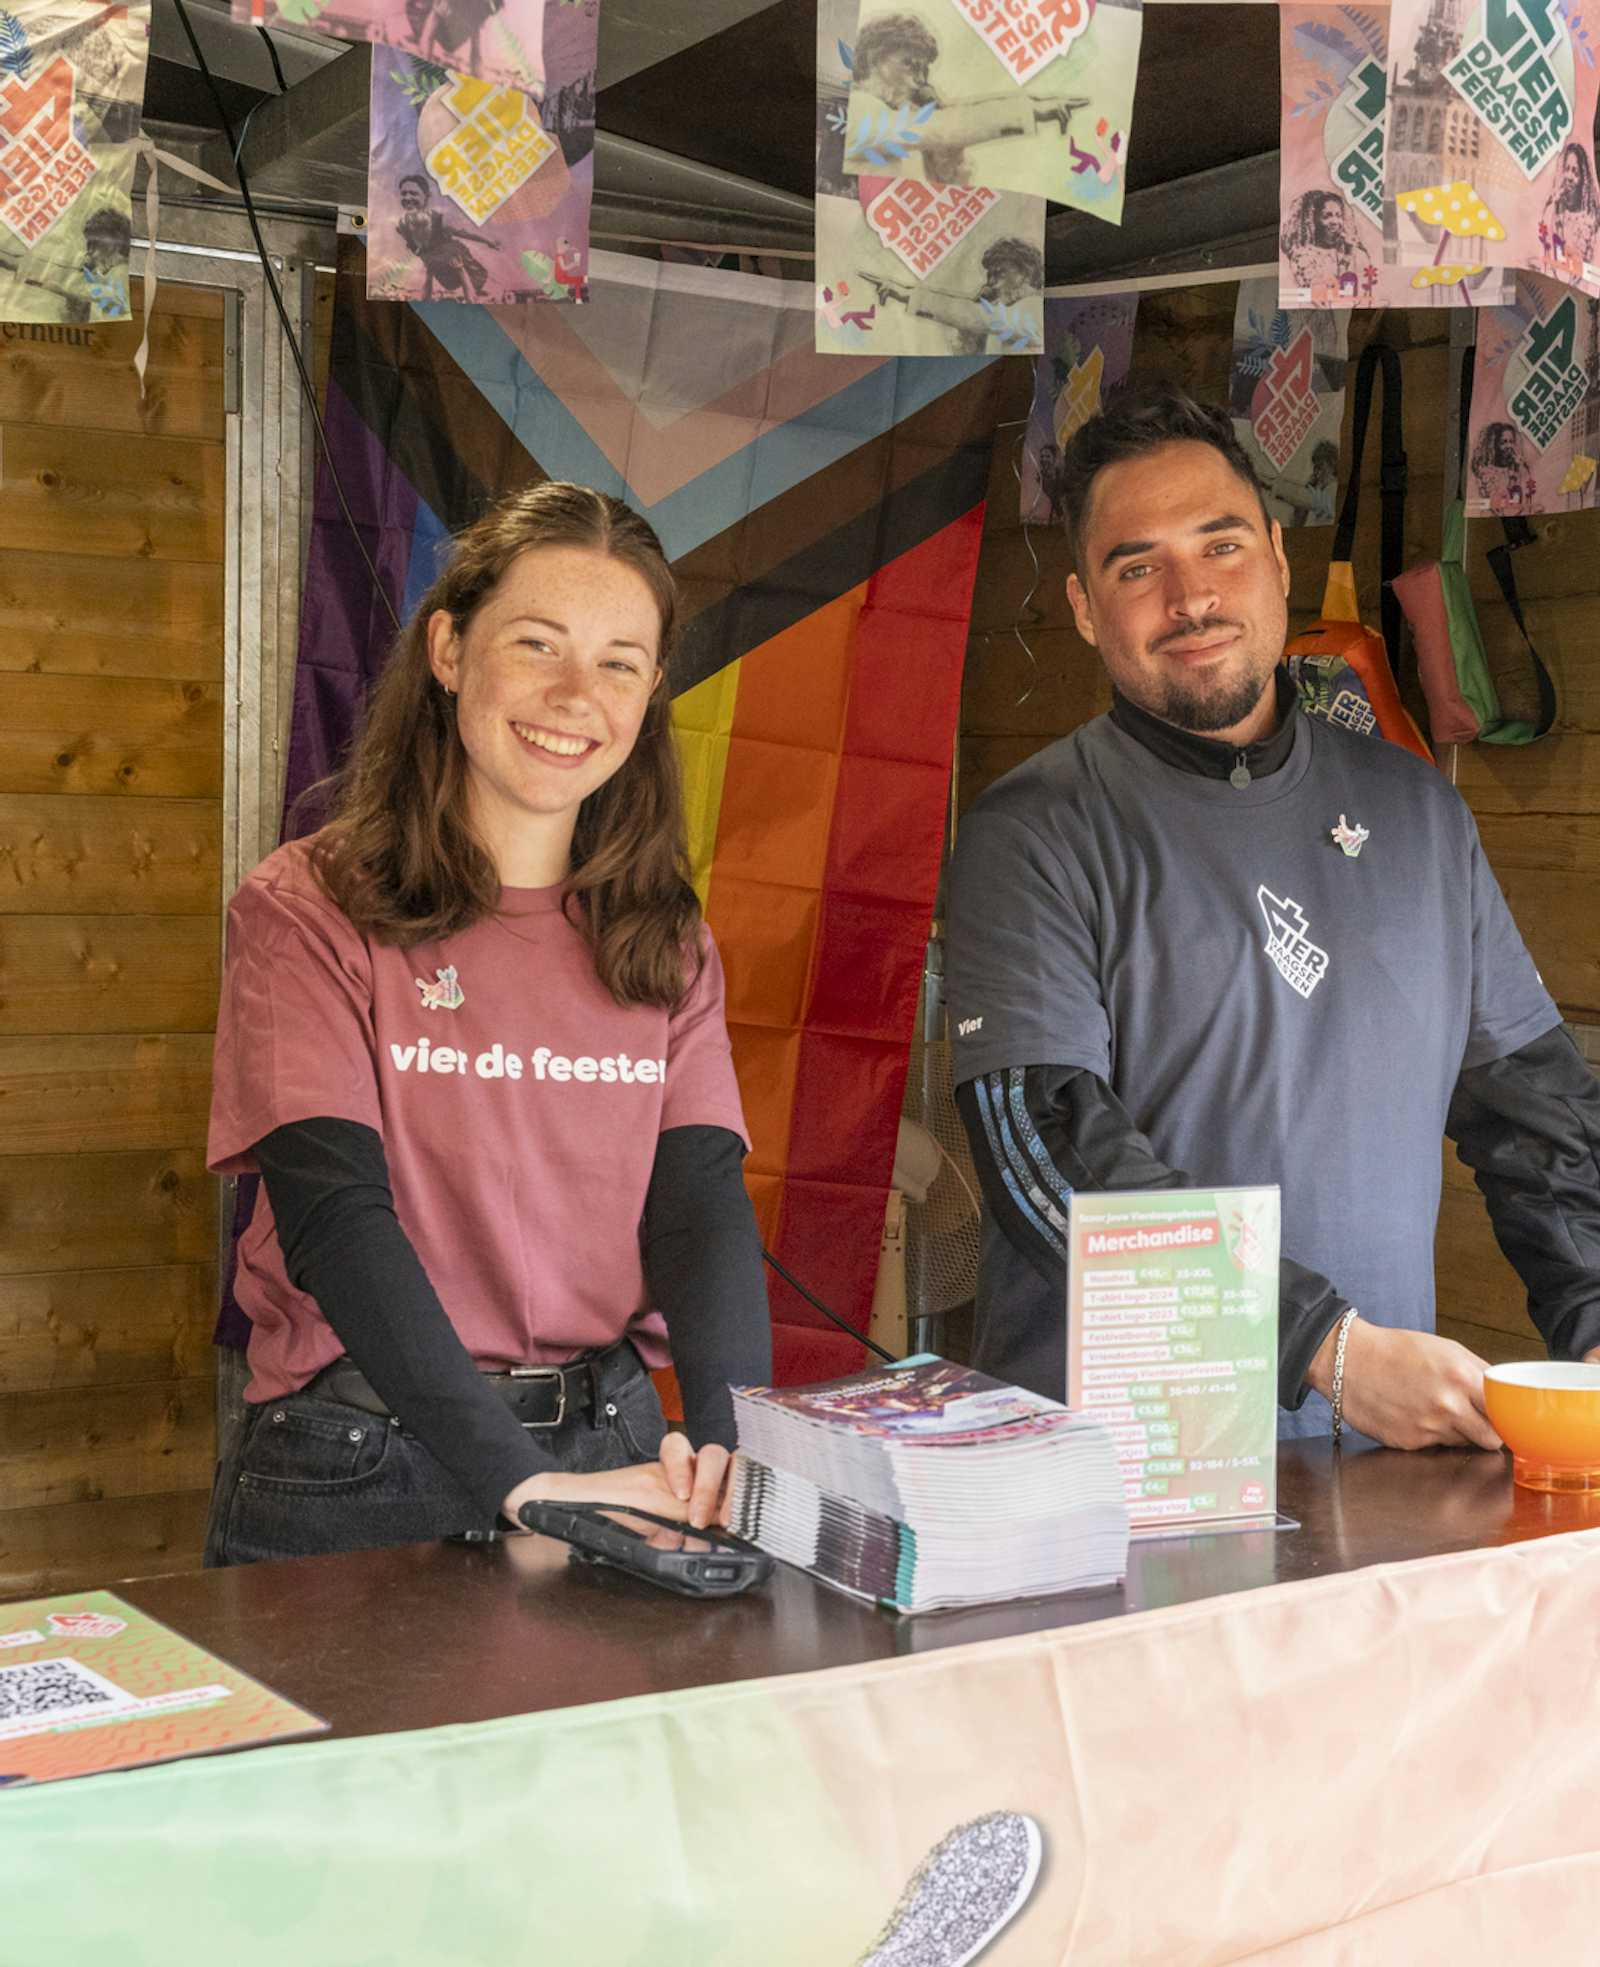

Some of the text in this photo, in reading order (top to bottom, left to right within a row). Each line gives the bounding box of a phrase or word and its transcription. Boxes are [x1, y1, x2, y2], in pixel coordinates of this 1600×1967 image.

[1449, 58, 1540, 172] FEESTEN
[1466, 40, 1554, 156] DAAGSE
[475, 1043, 523, 1079] de
[1087, 1225, 1214, 1254] Merchandise
